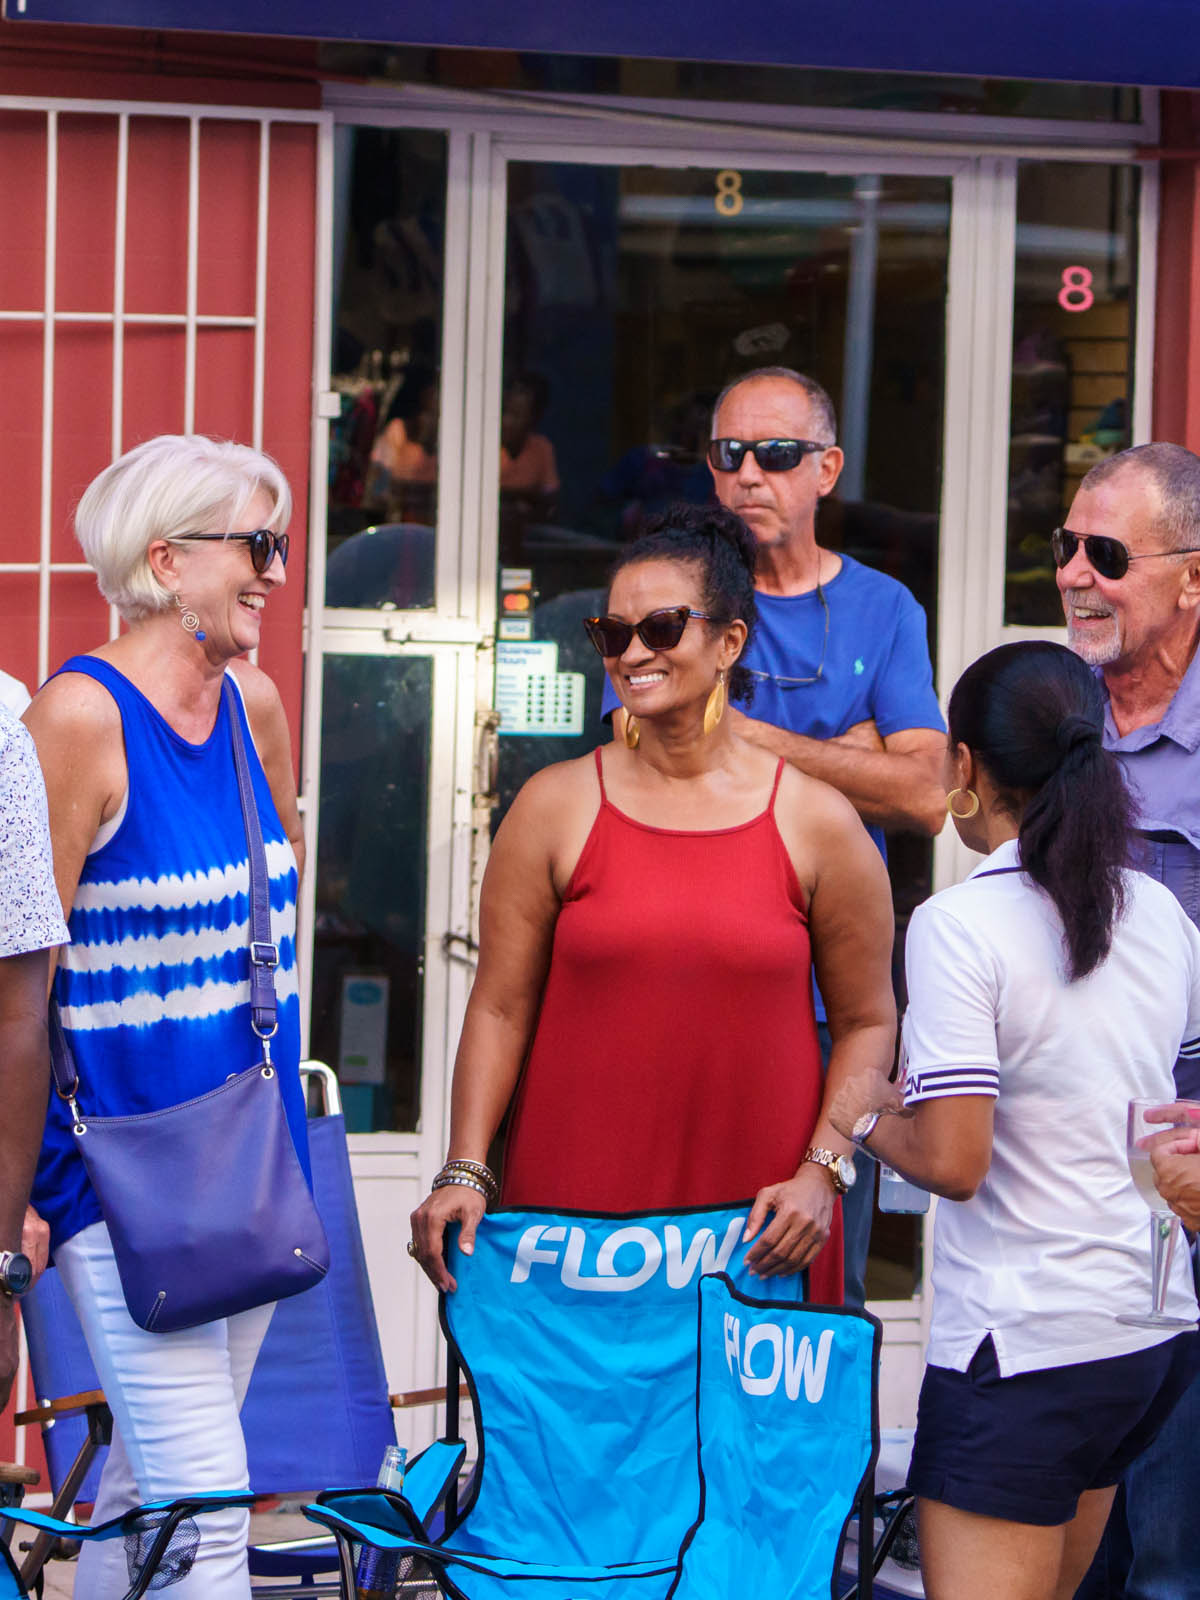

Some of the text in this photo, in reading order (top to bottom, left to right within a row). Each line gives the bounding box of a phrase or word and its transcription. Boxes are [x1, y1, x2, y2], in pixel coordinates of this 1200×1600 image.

[714, 170, 743, 216] 8
[1058, 265, 1094, 312] 8
[510, 1217, 746, 1292] FLOW
[724, 1312, 835, 1404] FLOW
